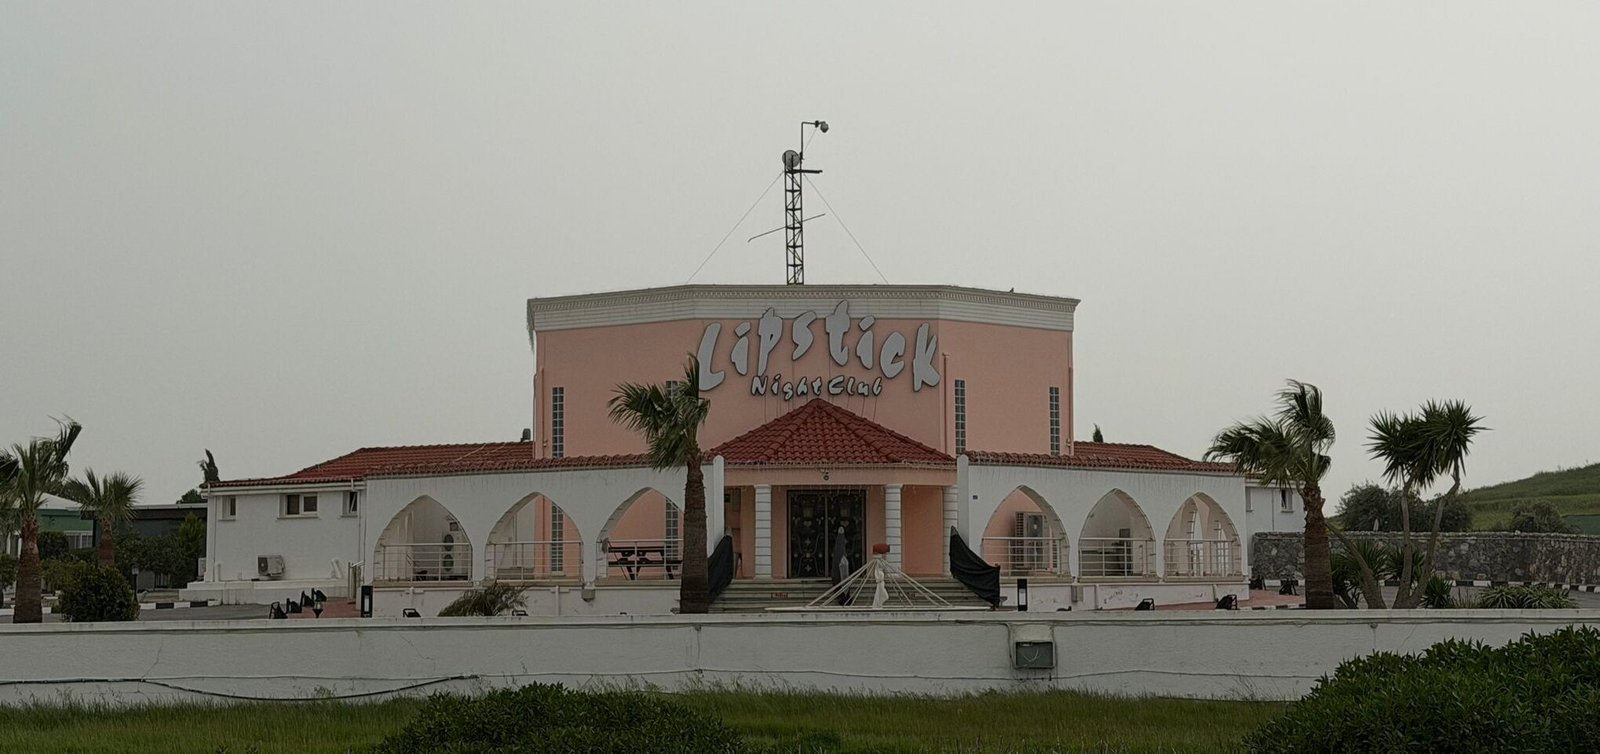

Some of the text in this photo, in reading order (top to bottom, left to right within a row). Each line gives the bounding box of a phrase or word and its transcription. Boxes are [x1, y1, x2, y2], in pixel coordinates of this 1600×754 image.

[696, 299, 940, 392] Lipstick
[751, 374, 883, 400] Night Club
